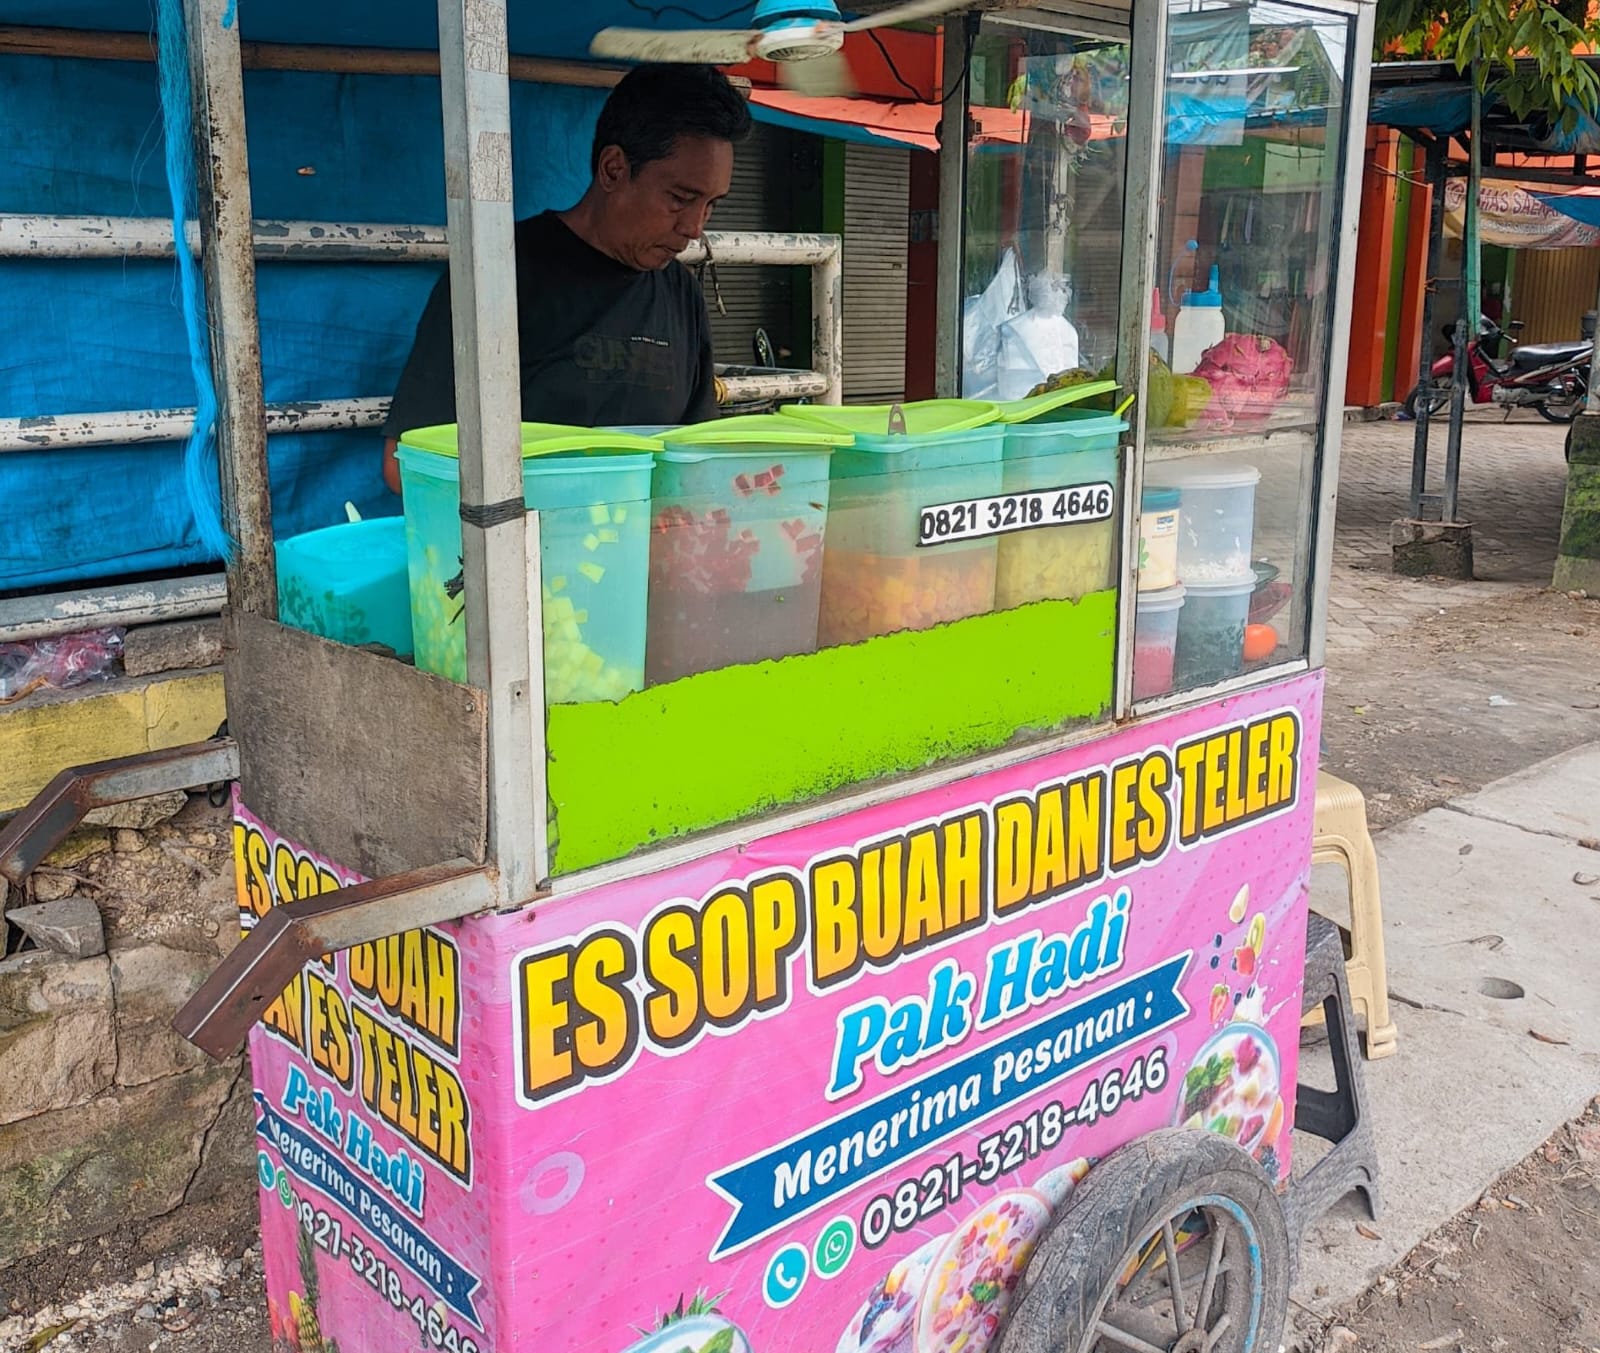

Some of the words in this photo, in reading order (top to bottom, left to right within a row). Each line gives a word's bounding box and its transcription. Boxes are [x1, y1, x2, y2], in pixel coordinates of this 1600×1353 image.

[920, 502, 978, 539] 0821
[986, 496, 1044, 529] 3218
[1051, 488, 1110, 520] 4646
[521, 930, 634, 1097] ES
[645, 876, 802, 1044] SOP
[810, 811, 985, 983] BUAH
[994, 772, 1104, 913] DAN
[1108, 752, 1173, 869] ES
[1175, 711, 1300, 844] TELER
[828, 963, 974, 1094] Pak
[980, 891, 1129, 1025] Hadi
[283, 1065, 344, 1147] Pak
[344, 1116, 425, 1217] Hadi
[307, 971, 354, 1085] ES
[350, 1003, 471, 1179] TELER
[773, 1071, 981, 1209] Menerima
[992, 997, 1136, 1095] Pesanan
[861, 1048, 1169, 1247] 0821-3218-4646
[359, 1188, 443, 1284] Pesanan
